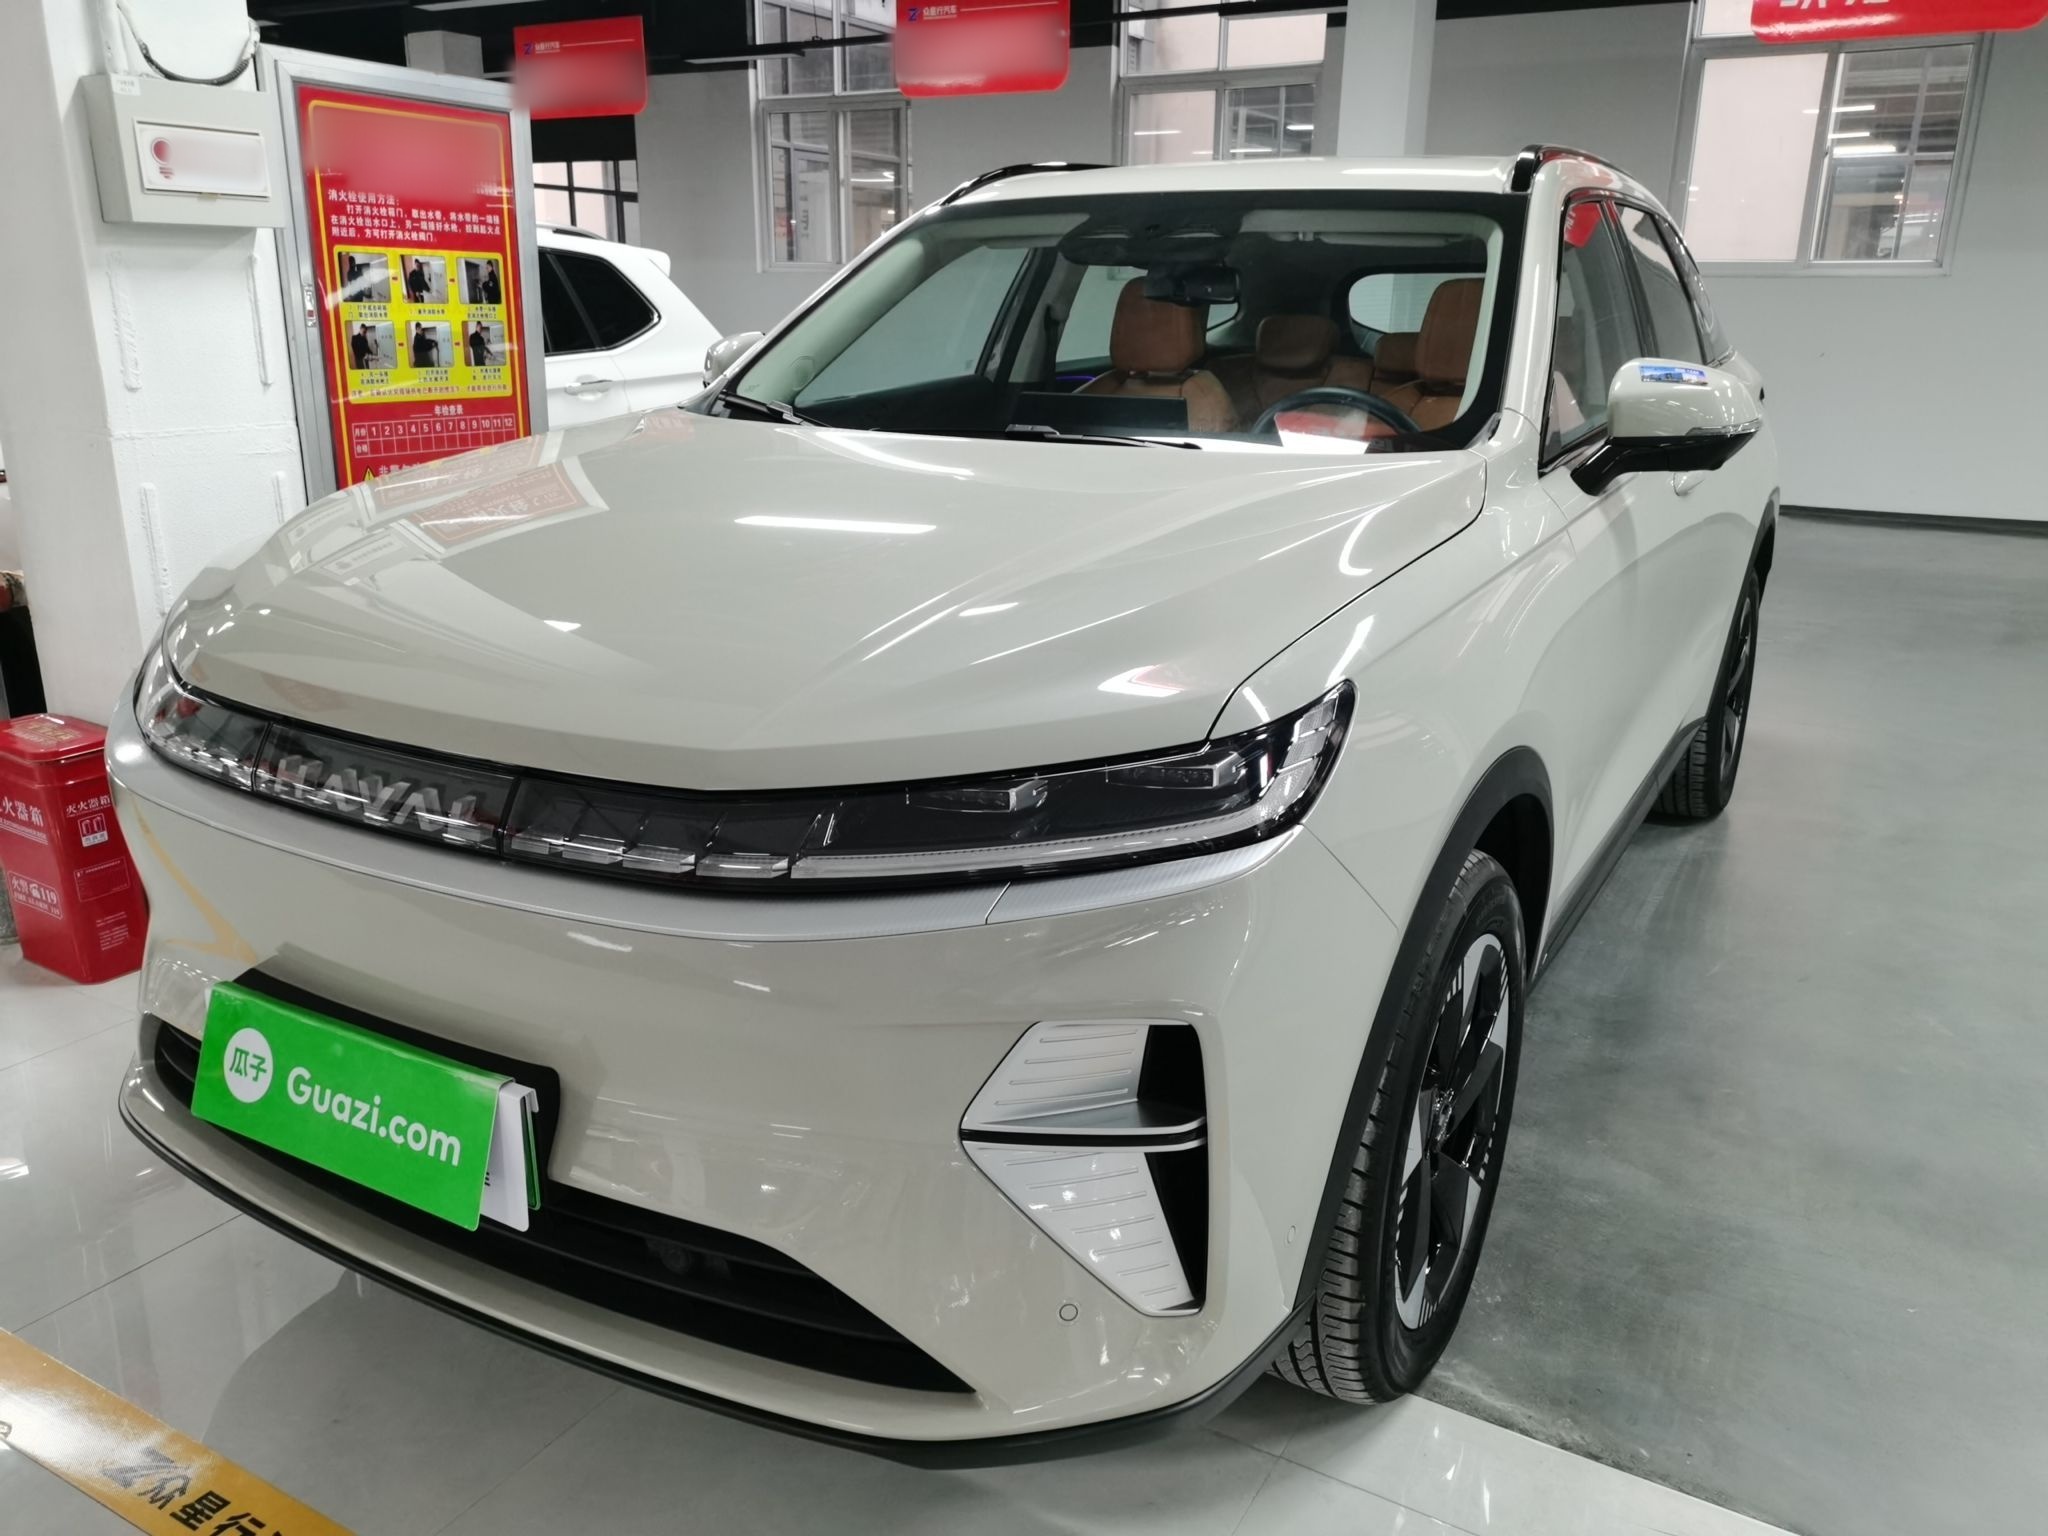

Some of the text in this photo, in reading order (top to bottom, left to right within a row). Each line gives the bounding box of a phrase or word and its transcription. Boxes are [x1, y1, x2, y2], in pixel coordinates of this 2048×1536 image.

[372, 427, 377, 436] 1
[384, 426, 390, 436] 2
[398, 425, 404, 435] 3
[410, 424, 417, 434] 4
[423, 423, 429, 433] 5
[436, 422, 442, 432] 6
[448, 422, 454, 431] 7
[460, 421, 466, 430] 8
[472, 420, 478, 430] 9
[482, 419, 490, 429] 10
[493, 418, 501, 428] 11
[504, 417, 513, 427] 12
[0, 796, 44, 827] 火器箱
[274, 755, 494, 842] HAVAL
[229, 1047, 268, 1083] 瓜子
[286, 1066, 461, 1167] Guazi.com
[137, 1473, 287, 1536] 众星行
